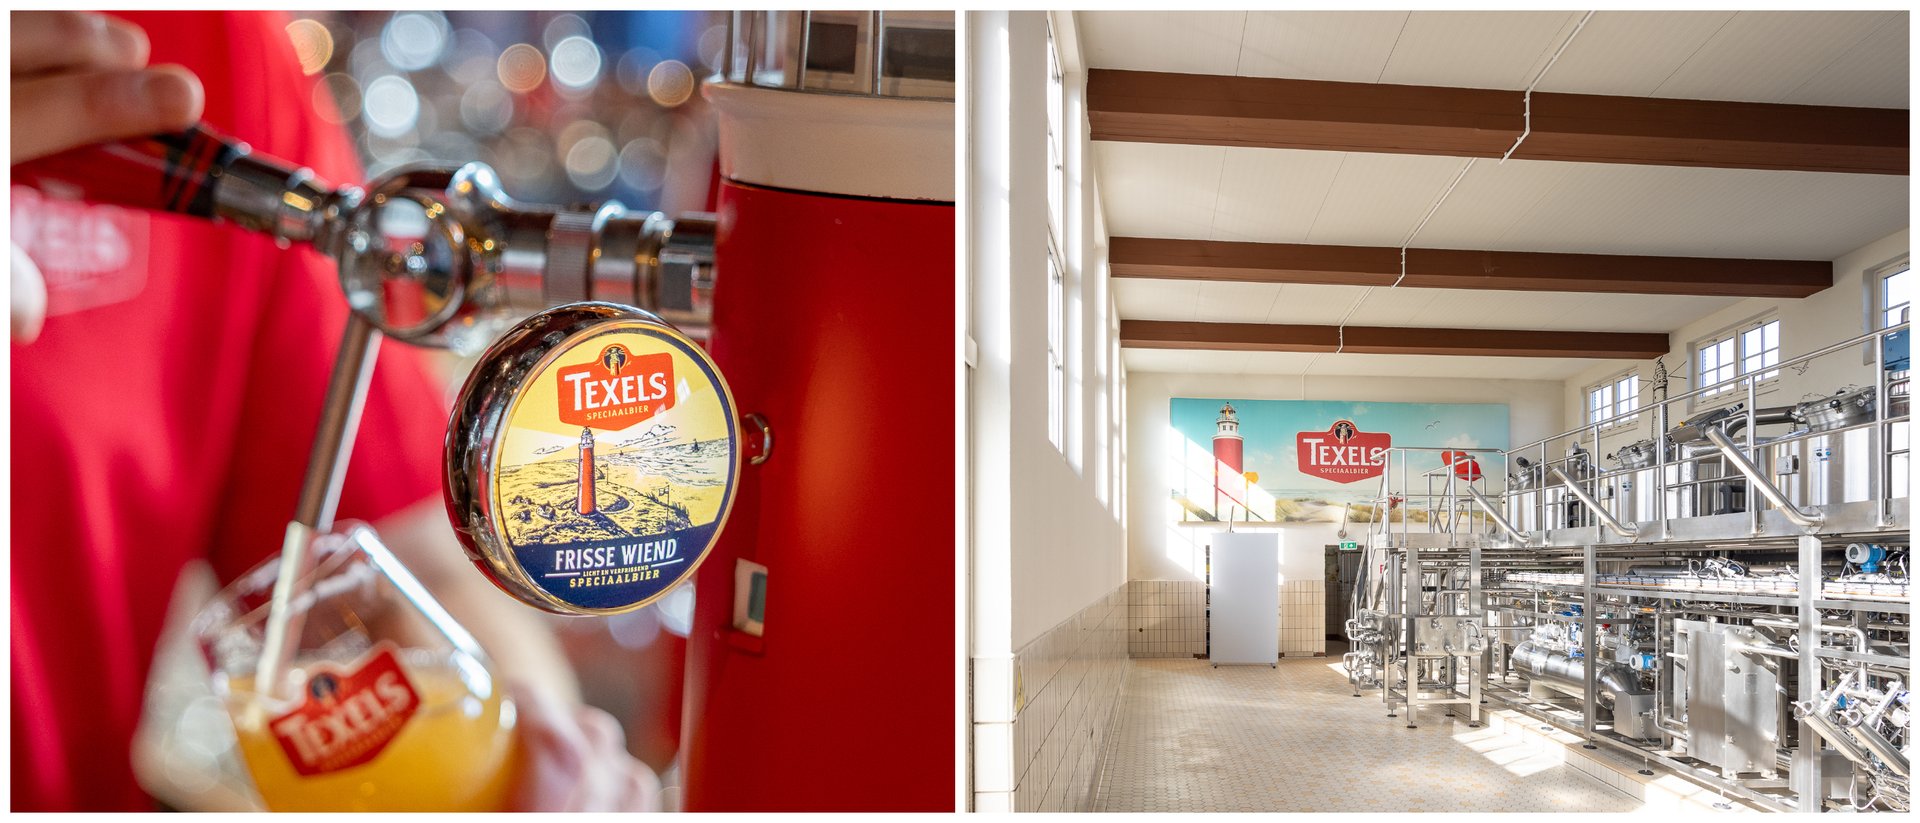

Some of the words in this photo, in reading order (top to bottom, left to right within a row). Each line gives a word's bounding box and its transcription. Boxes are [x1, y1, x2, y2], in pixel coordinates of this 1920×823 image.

[564, 371, 667, 411] TEXELS
[586, 405, 649, 420] SPECIAALBIER
[1303, 438, 1384, 466] TEXELS
[555, 546, 616, 571] FRISSE
[621, 538, 677, 565] WIEND
[569, 569, 660, 588] SPECIAALBIER
[610, 564, 649, 575] VERFRISSEND
